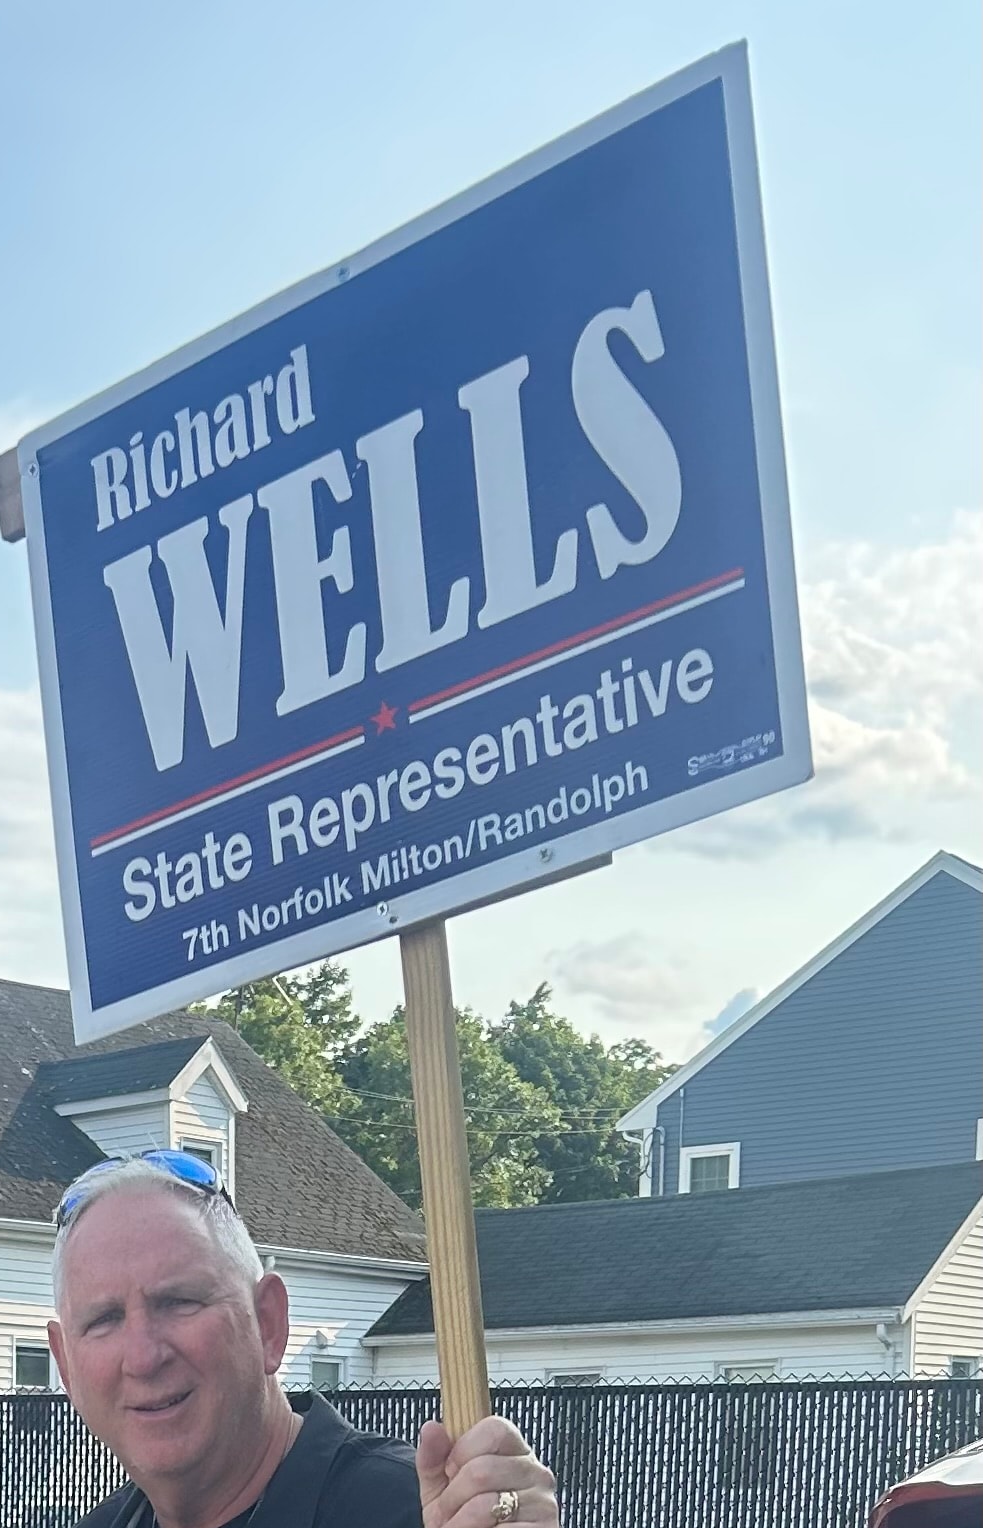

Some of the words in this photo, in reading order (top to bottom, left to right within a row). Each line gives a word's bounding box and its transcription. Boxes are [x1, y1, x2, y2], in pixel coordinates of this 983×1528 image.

[91, 346, 315, 531] Richard
[104, 291, 681, 771] WELLS
[123, 832, 252, 921] State
[268, 649, 713, 865] Representative
[183, 920, 229, 960] 7th
[238, 874, 352, 940] Norfolk
[361, 762, 648, 894] Milton/Randolph
